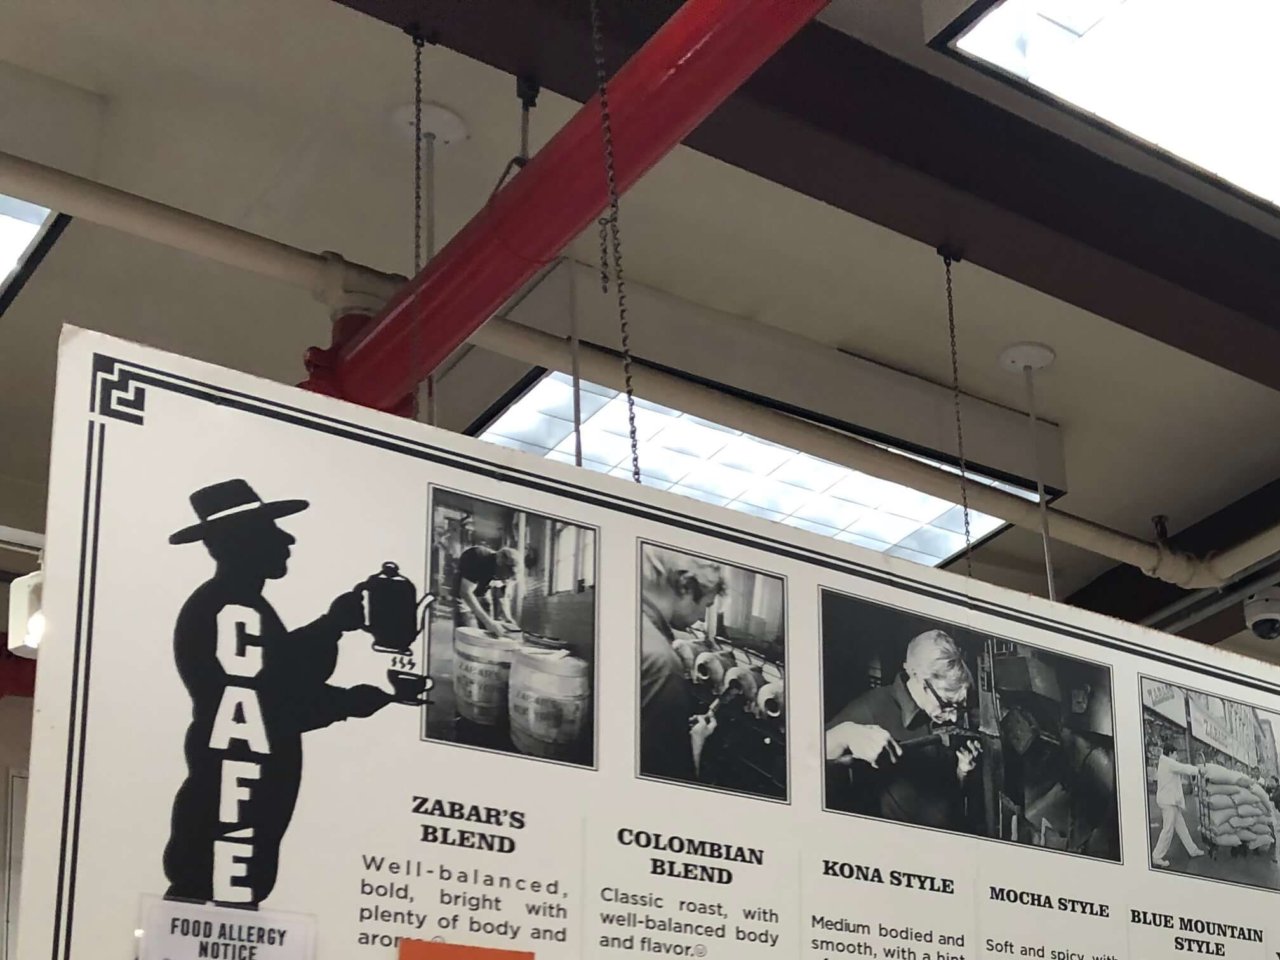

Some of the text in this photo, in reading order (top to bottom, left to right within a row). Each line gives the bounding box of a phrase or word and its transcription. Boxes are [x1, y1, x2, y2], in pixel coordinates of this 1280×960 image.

[411, 795, 526, 830] ZABAR'S
[419, 825, 517, 855] BLEND
[617, 828, 764, 866] COLOMBIAN
[361, 854, 569, 899] Well-balanced,
[650, 858, 734, 886] BLEND
[822, 860, 955, 895] KONA STYLE
[360, 879, 568, 919] bold, bright with
[600, 887, 779, 924] Classic roast, with
[989, 886, 1110, 918] MOCHA STYLE
[171, 917, 287, 946] FOOD ALLERGY
[359, 903, 568, 943] plenty of body and
[600, 910, 779, 947] well-balanced body
[811, 915, 965, 947] Medium bodied and
[1130, 909, 1264, 943] BLUE MOUNTAIN
[599, 931, 695, 957] and flavor.
[811, 938, 877, 960] smooth,
[986, 938, 1014, 956] Soft
[1020, 944, 1046, 959] and
[1174, 937, 1226, 956] STYLE
